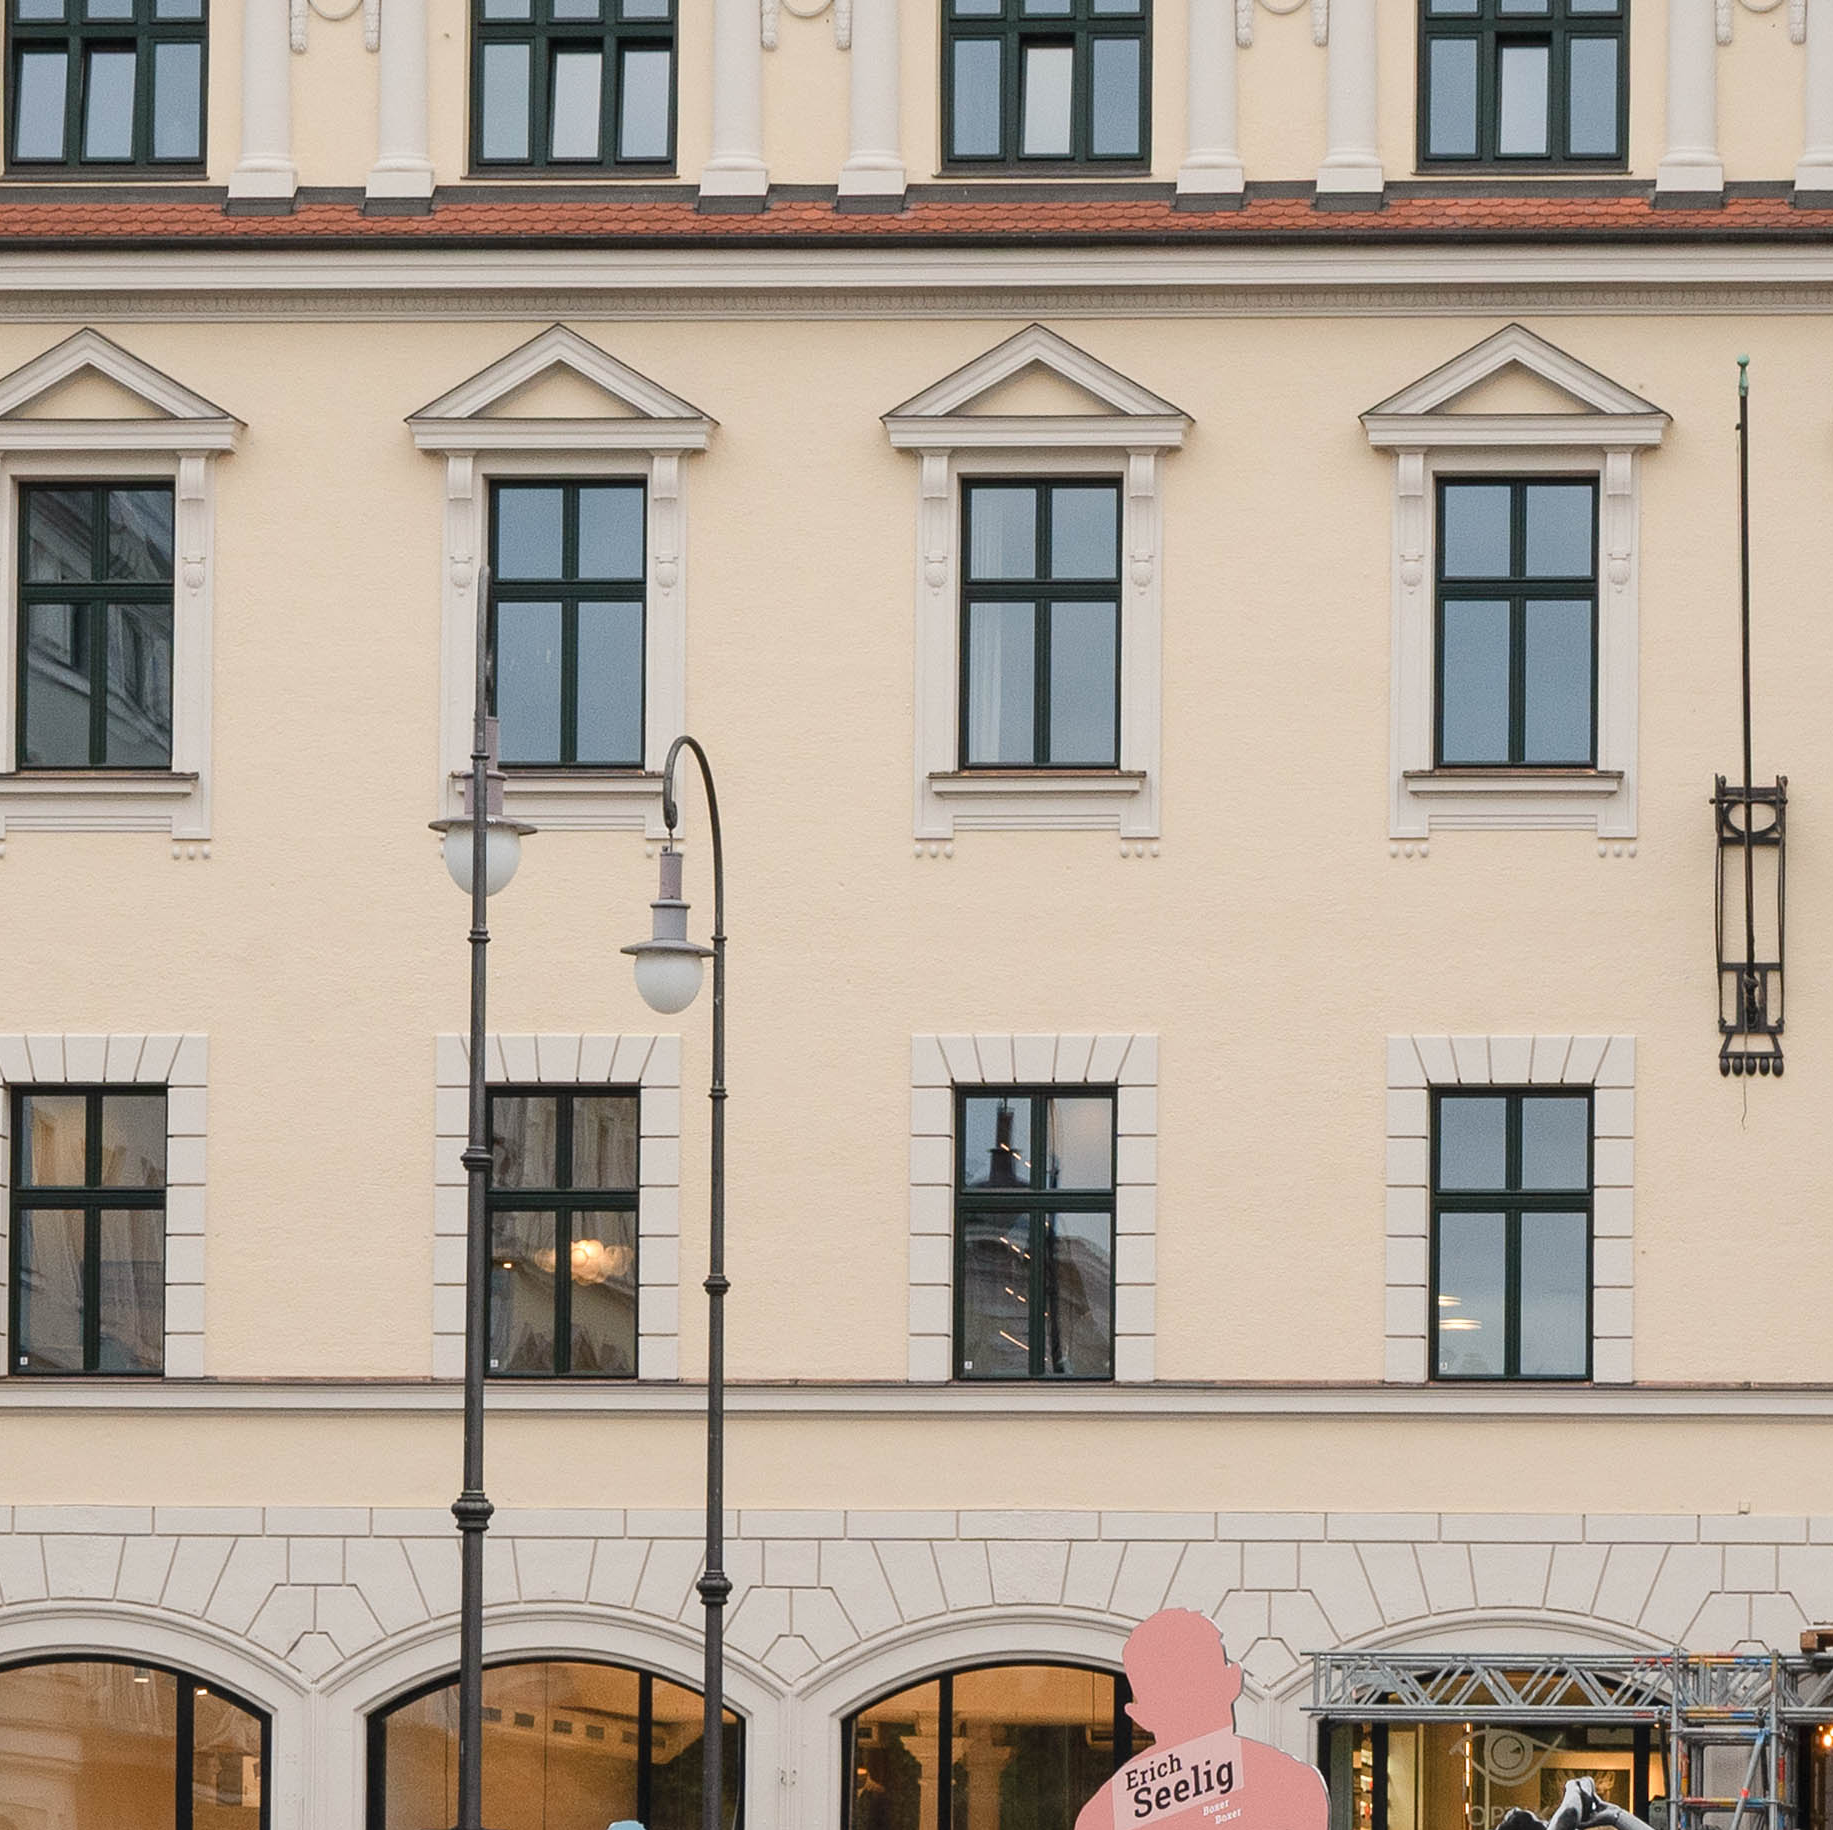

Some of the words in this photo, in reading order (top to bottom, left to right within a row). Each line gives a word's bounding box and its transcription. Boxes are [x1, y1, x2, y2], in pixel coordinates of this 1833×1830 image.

[1125, 1753, 1183, 1791] Erich
[1133, 1759, 1234, 1818] Seelig
[1202, 1799, 1230, 1817] Boxer
[1215, 1808, 1242, 1825] Boxer
